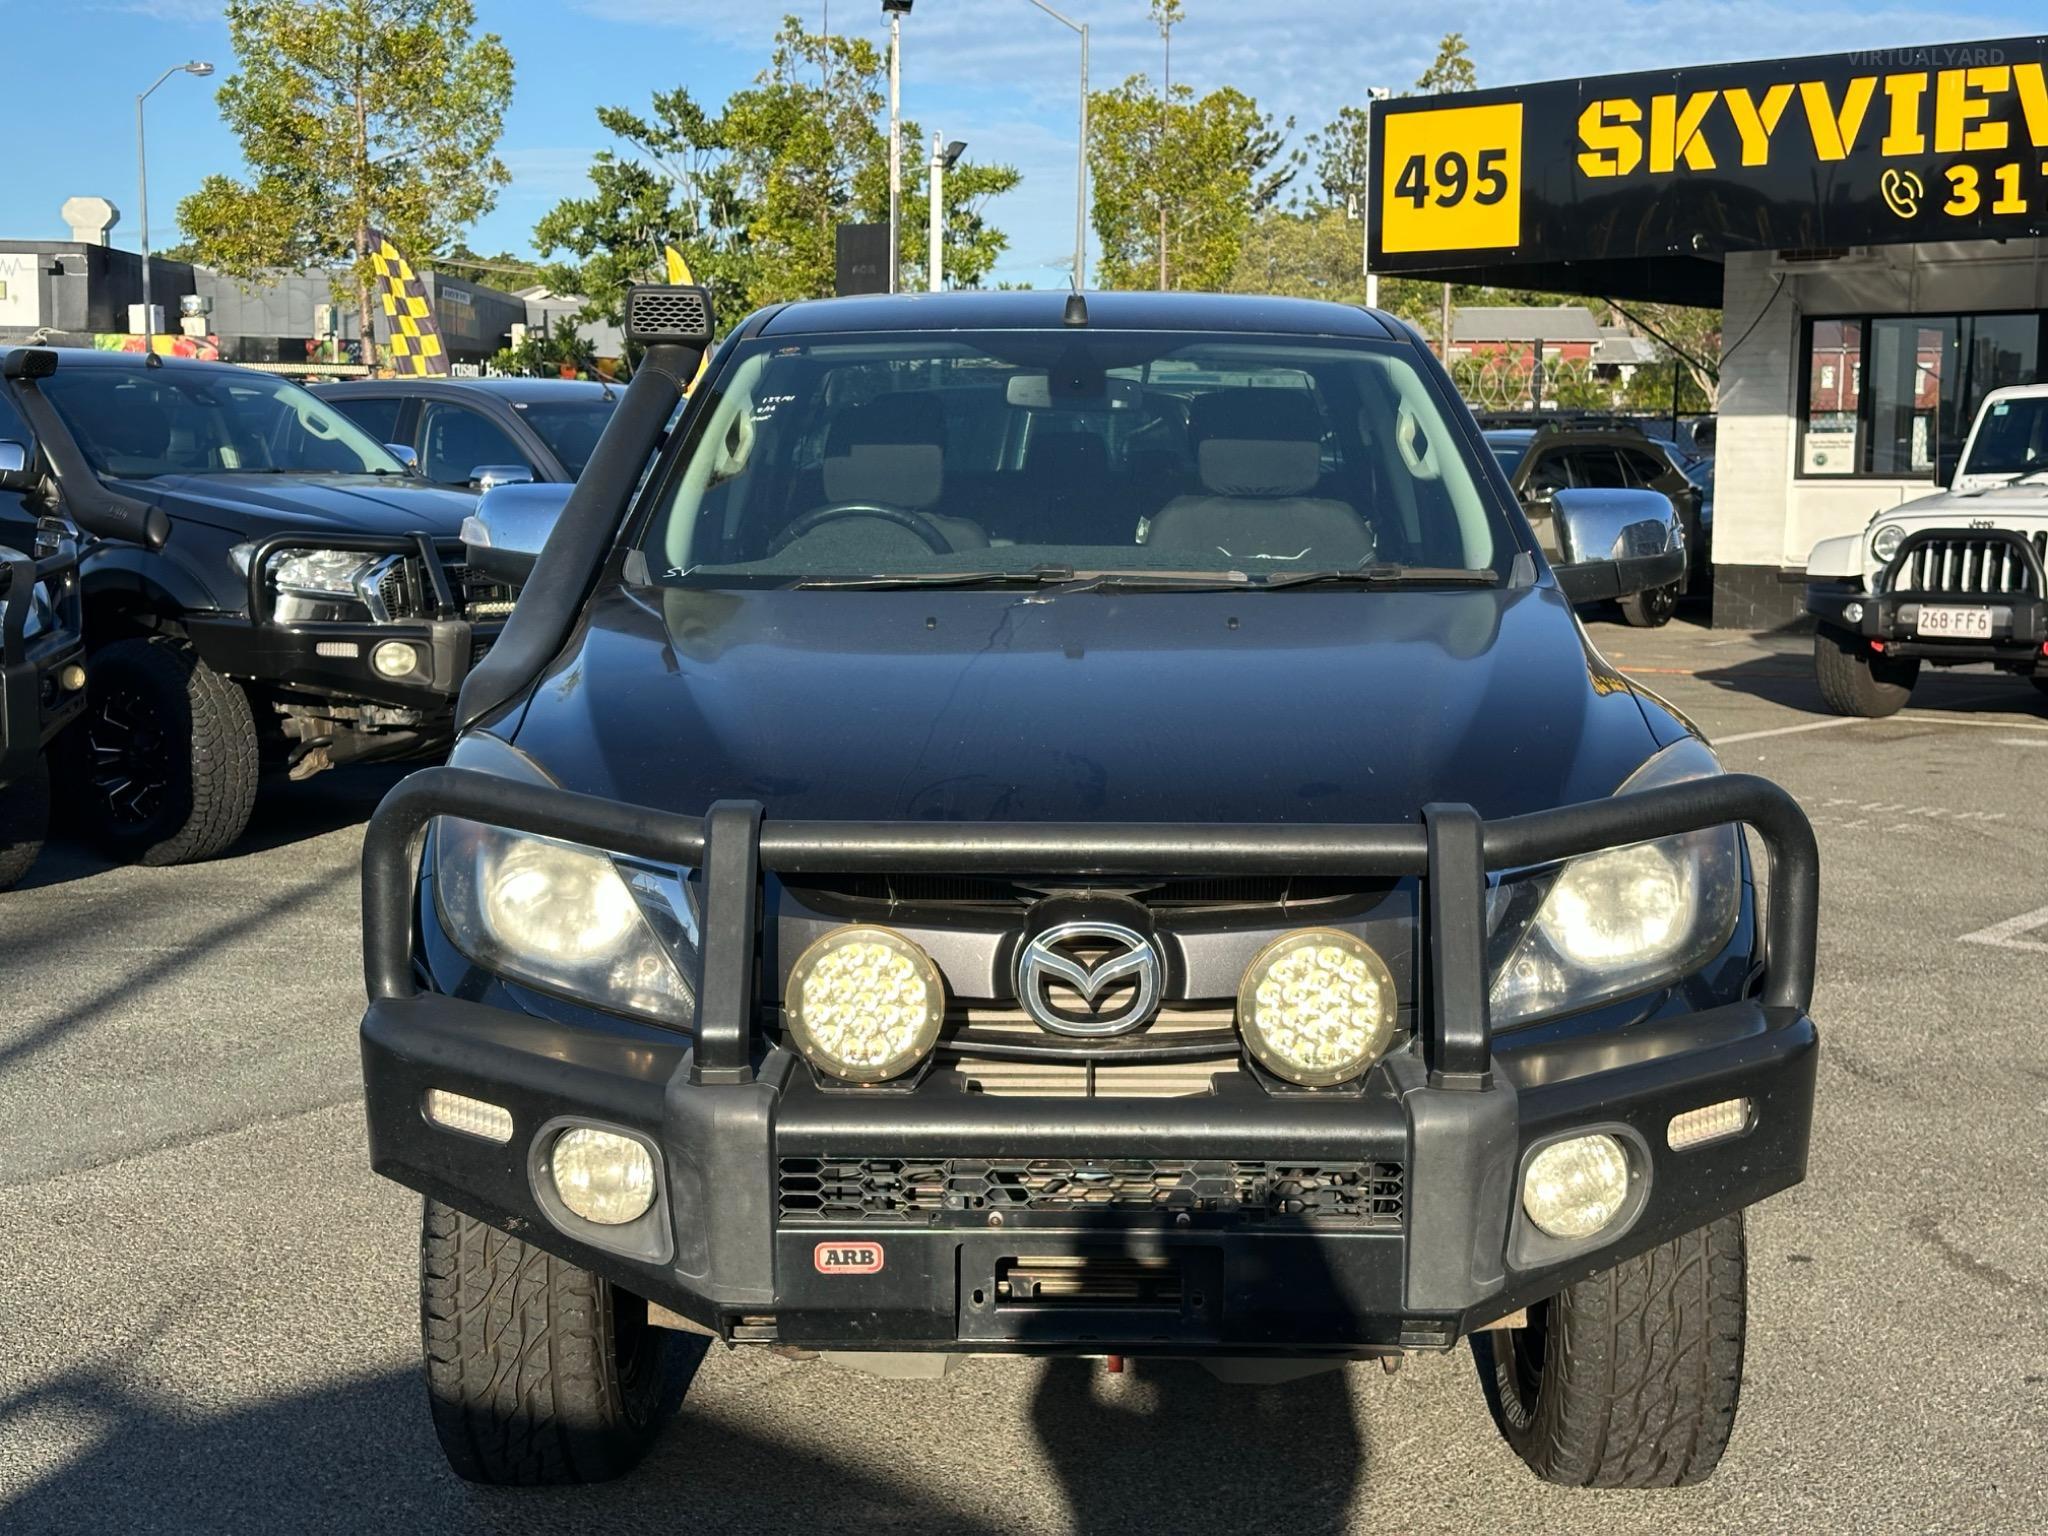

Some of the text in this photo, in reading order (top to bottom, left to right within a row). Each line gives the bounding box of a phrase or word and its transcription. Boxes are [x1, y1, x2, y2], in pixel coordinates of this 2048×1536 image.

[1394, 148, 1508, 210] 495
[1943, 162, 2048, 217] 31
[825, 1249, 875, 1266] ARB
